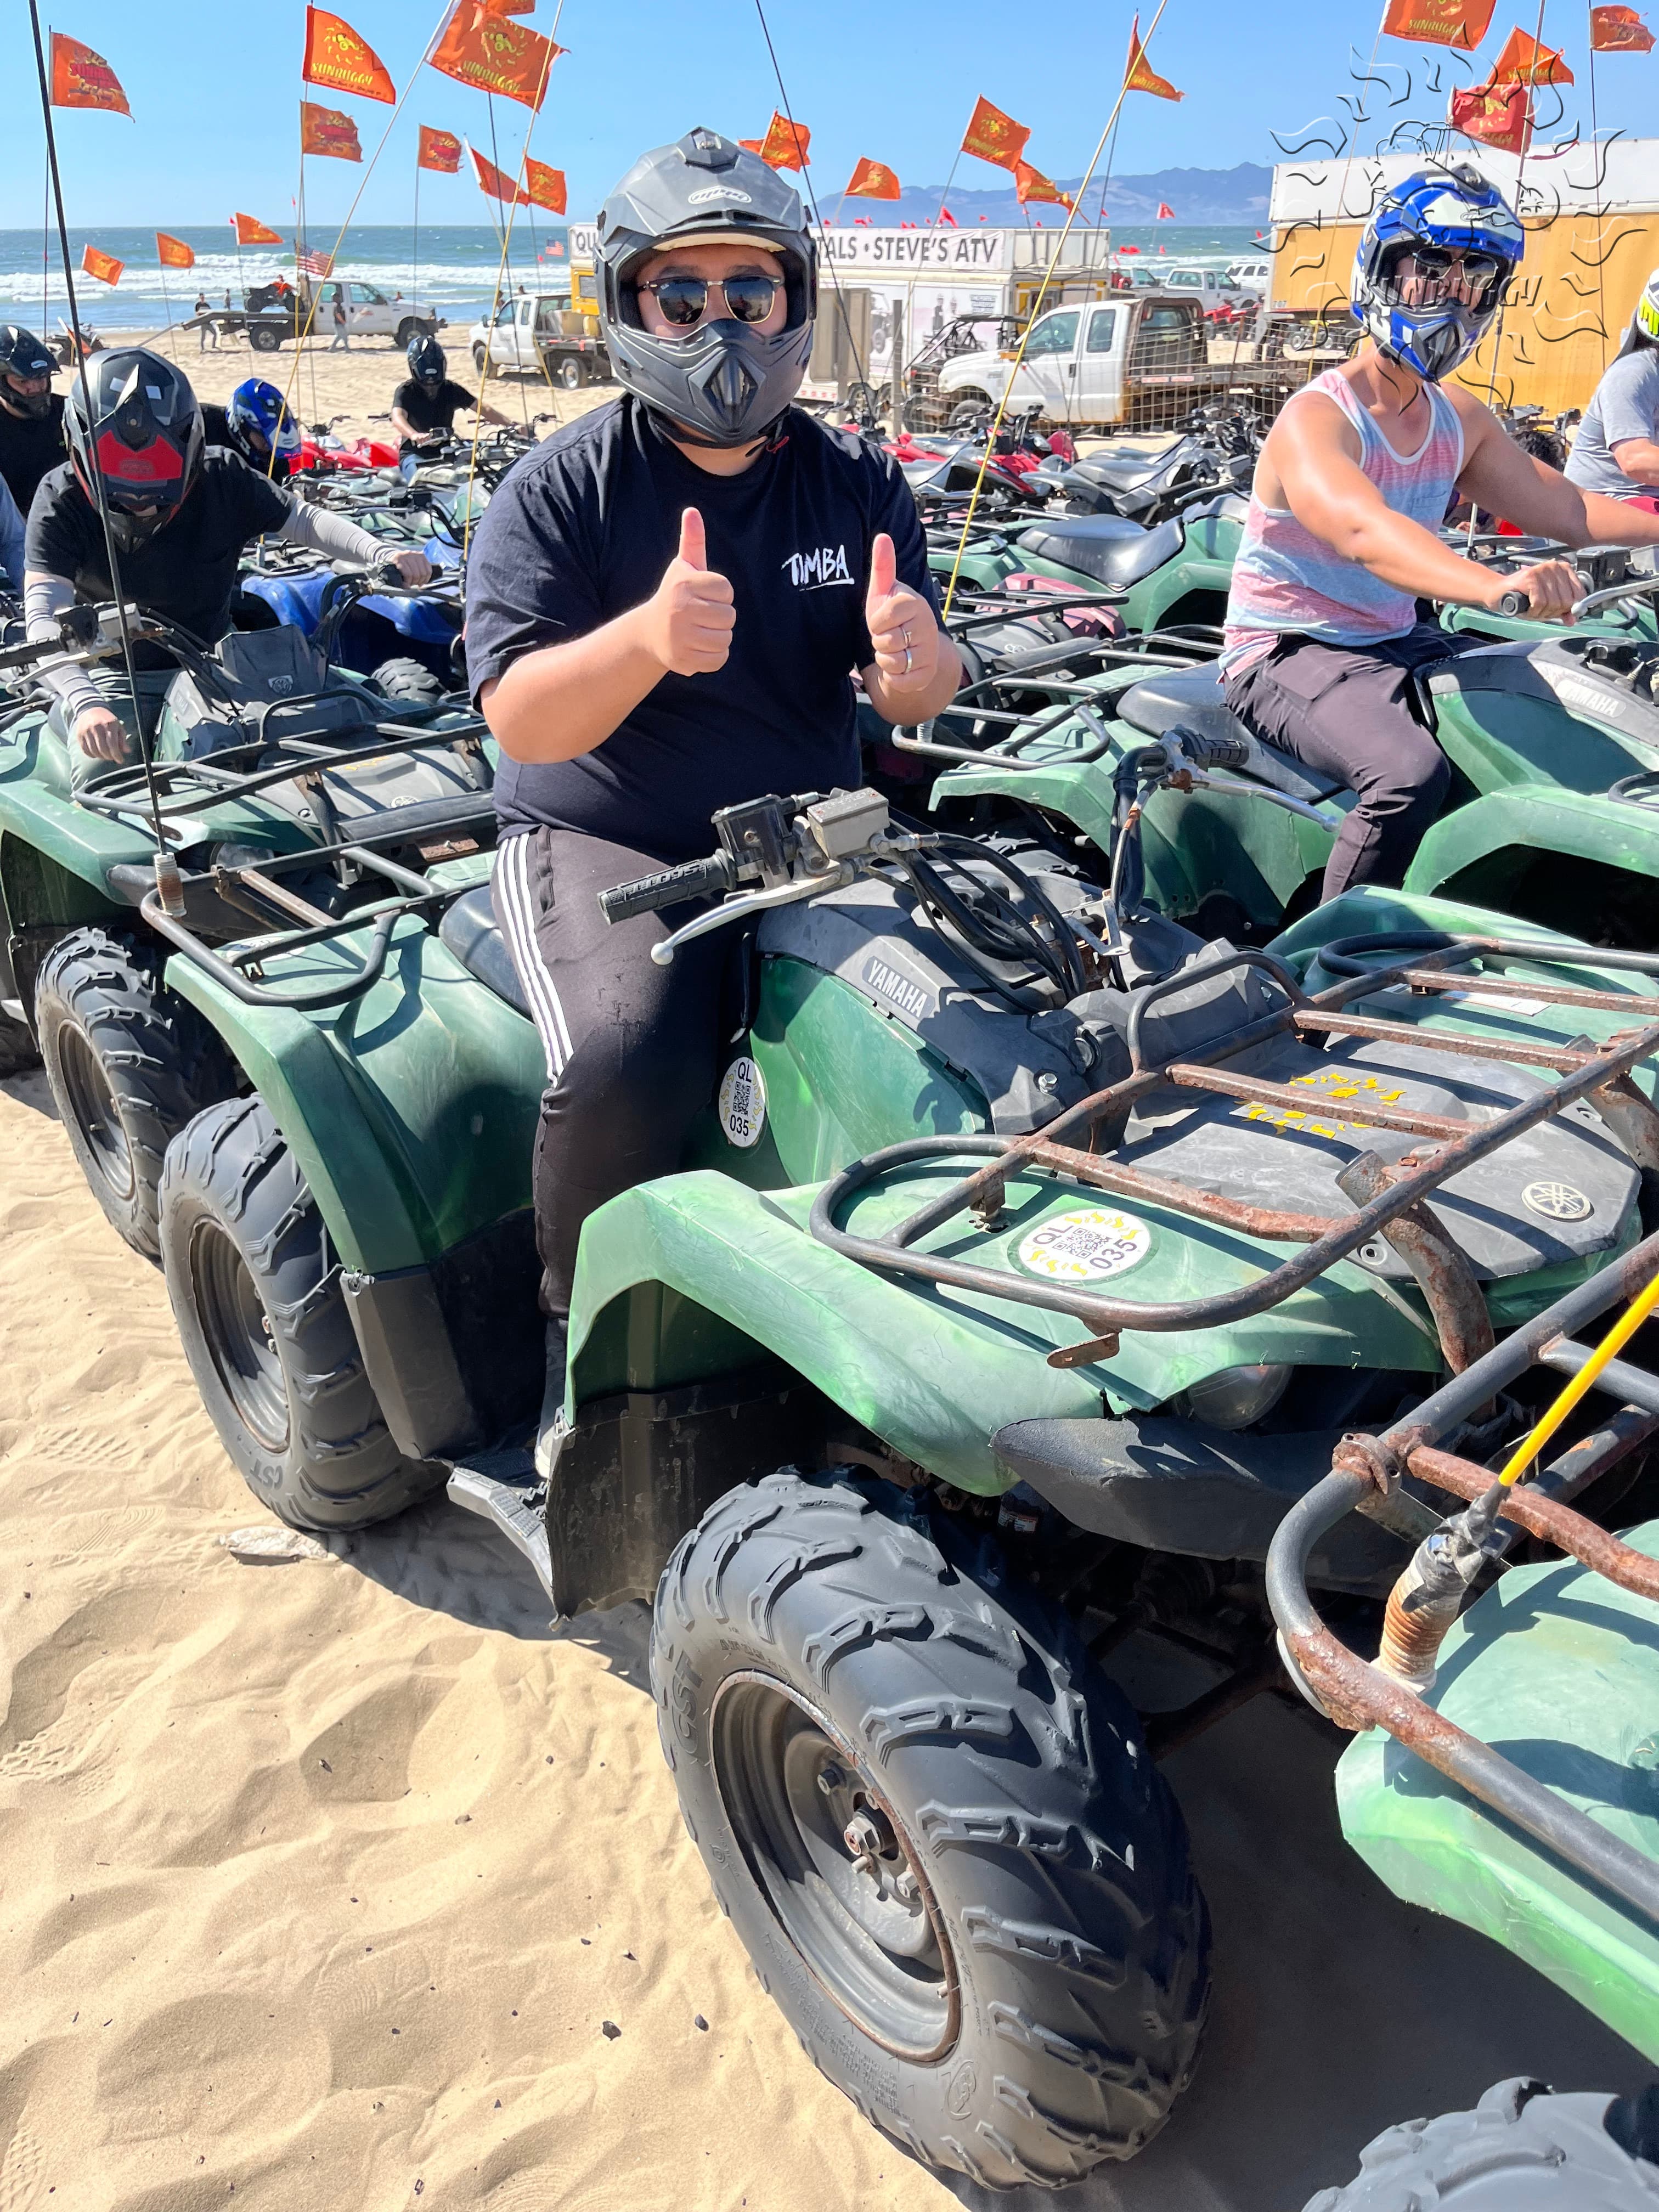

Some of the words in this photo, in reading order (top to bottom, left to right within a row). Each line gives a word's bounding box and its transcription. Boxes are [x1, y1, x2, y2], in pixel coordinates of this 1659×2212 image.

[312, 62, 373, 86] SUNBUGGY
[873, 236, 948, 262] STEVE'S
[956, 238, 997, 263] ATV
[781, 544, 852, 586] TIMBA
[1561, 682, 1620, 716] AMAHA
[868, 960, 928, 1017] YAMAHA
[737, 1062, 752, 1083] QL
[730, 1114, 749, 1137] 035
[1032, 1225, 1075, 1245] QL
[1089, 1238, 1138, 1269] 035
[672, 1650, 704, 1754] CST
